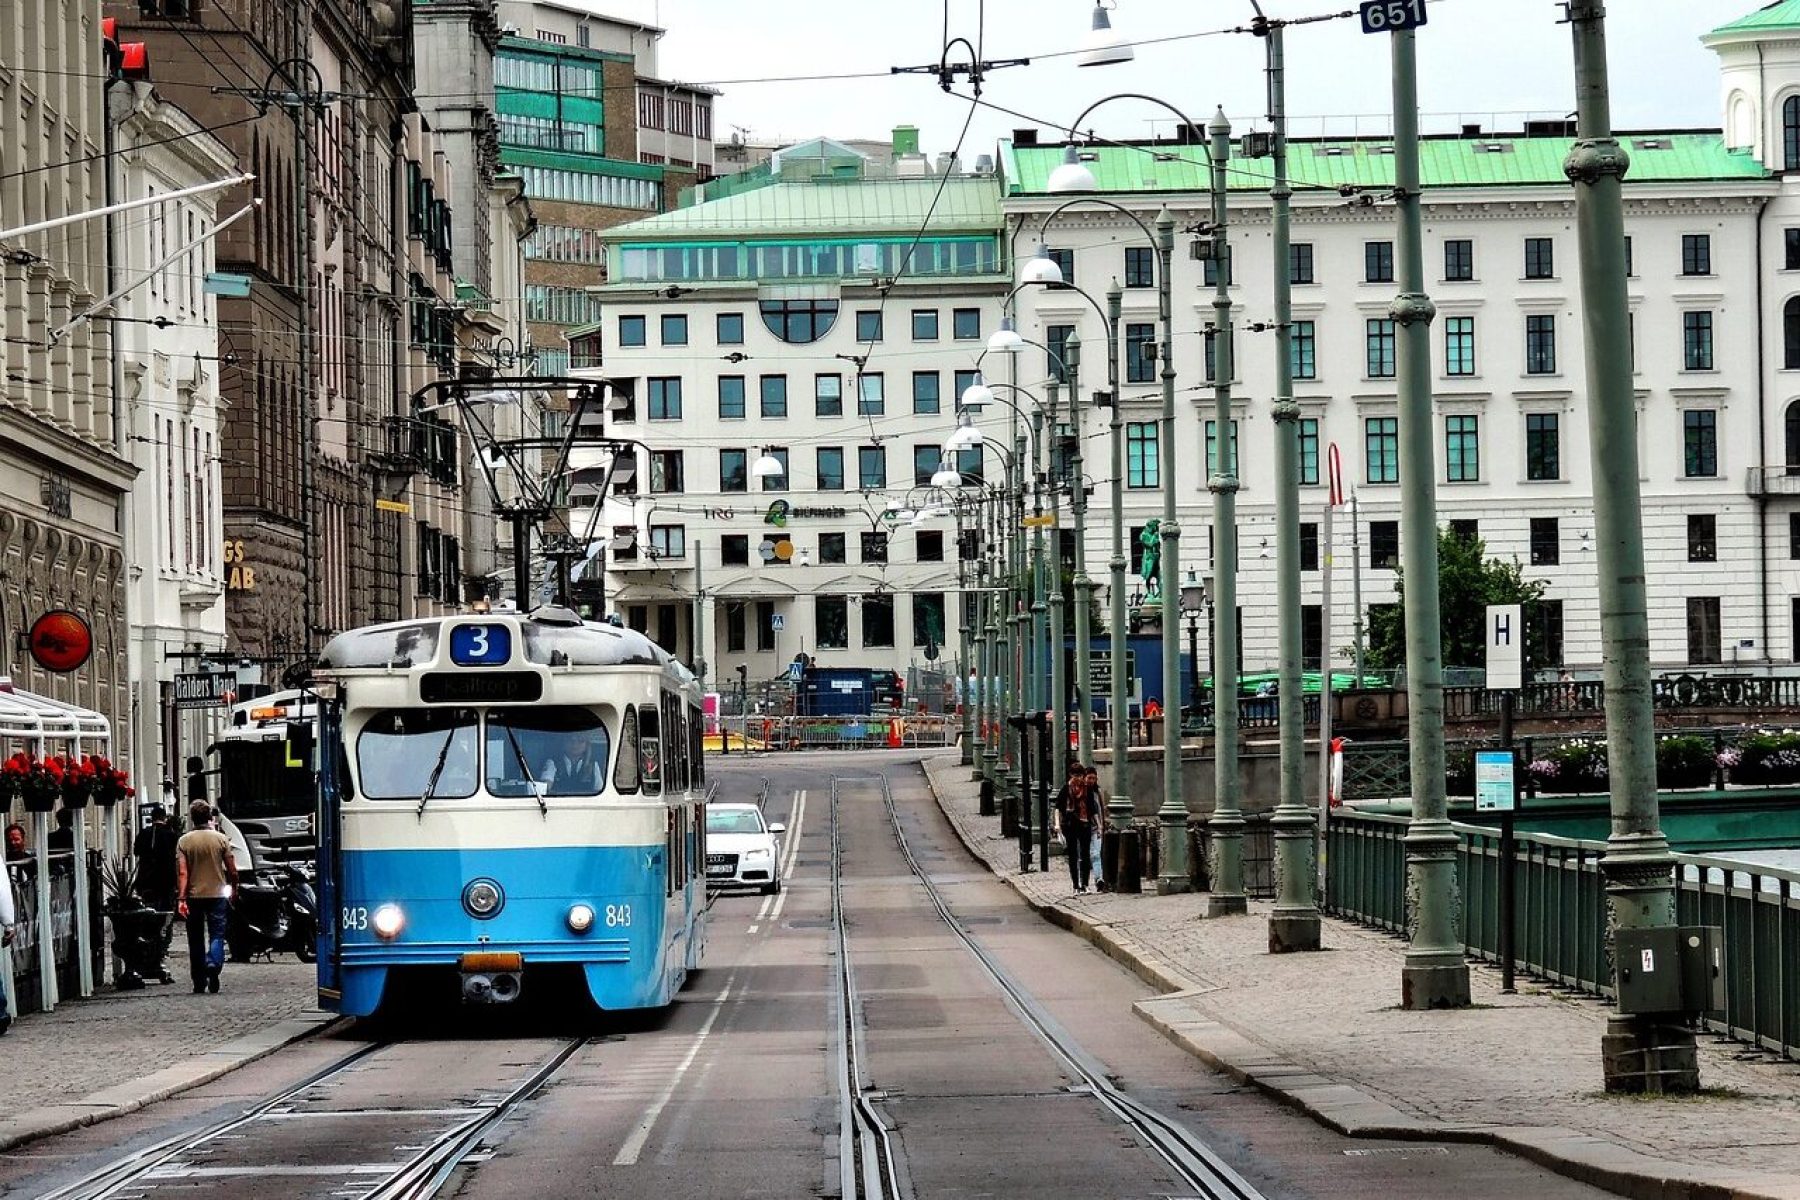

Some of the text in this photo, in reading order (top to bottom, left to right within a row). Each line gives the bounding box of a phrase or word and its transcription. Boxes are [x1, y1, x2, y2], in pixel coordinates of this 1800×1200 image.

[1366, 0, 1421, 28] 651
[229, 567, 256, 589] AB
[469, 626, 489, 657] 3
[1495, 614, 1510, 646] H
[176, 674, 209, 699] Balders
[342, 906, 368, 931] 843
[605, 904, 631, 928] 843
